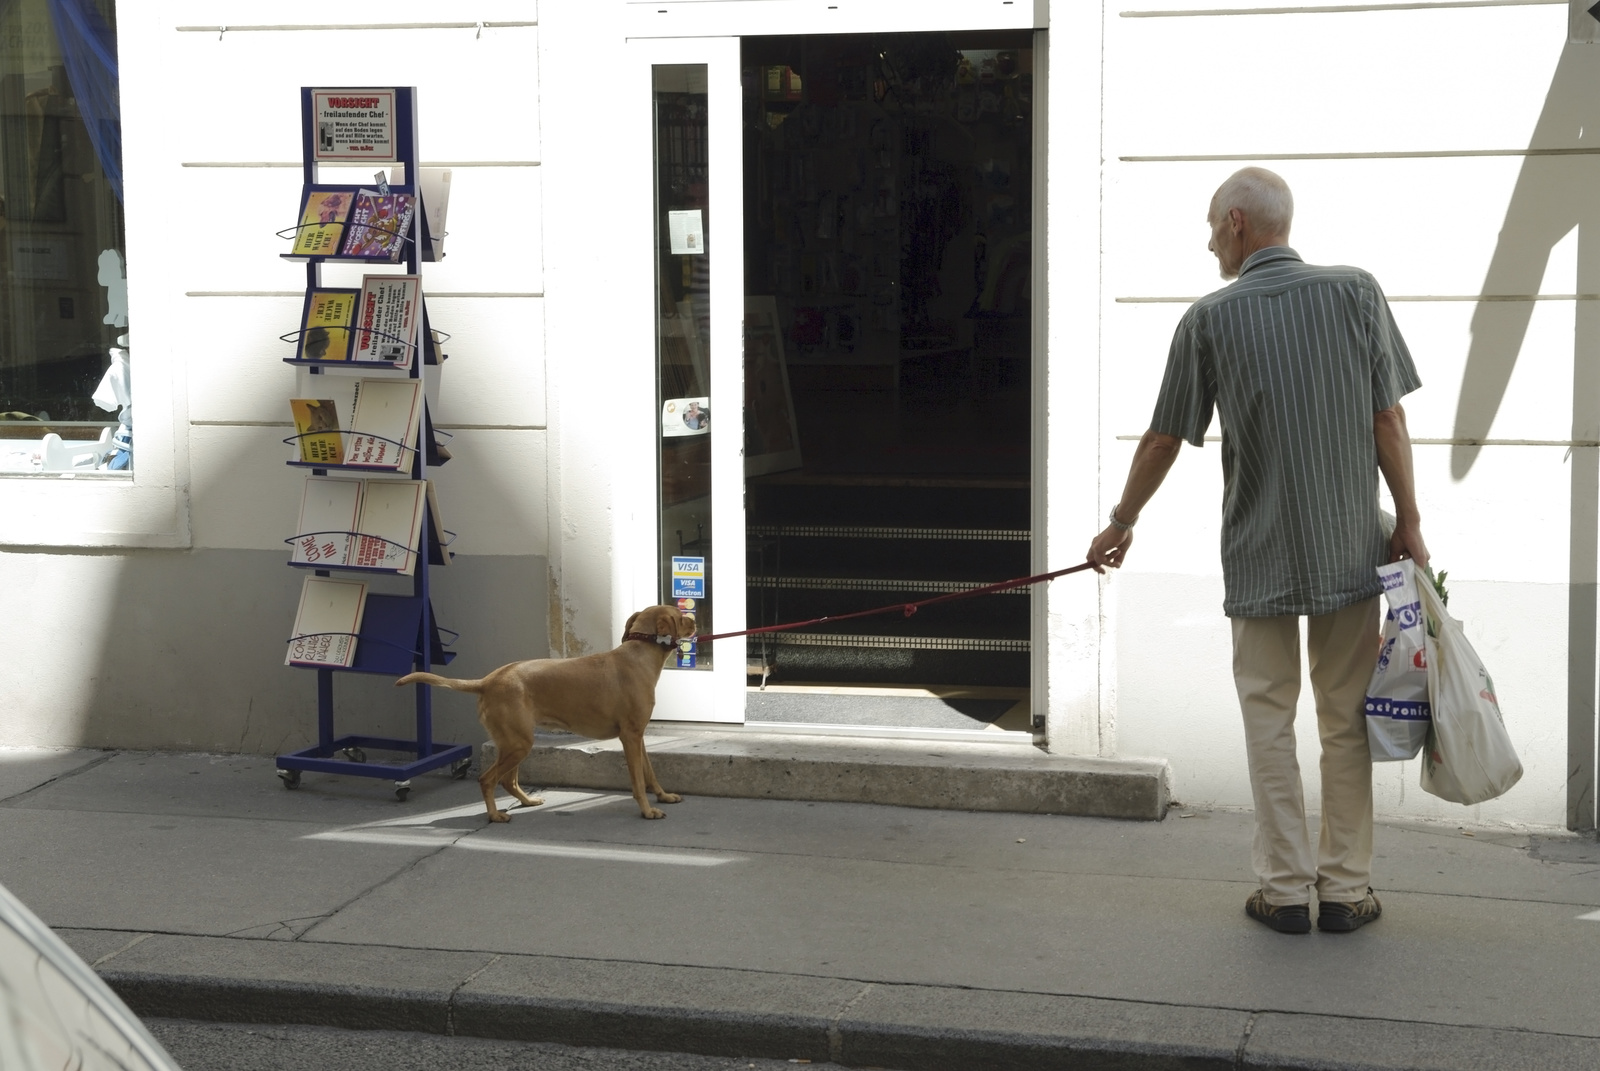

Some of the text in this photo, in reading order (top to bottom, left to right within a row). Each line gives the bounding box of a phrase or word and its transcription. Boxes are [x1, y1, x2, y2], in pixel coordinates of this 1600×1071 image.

[328, 97, 379, 109] VORSICHT
[304, 232, 315, 248] HIER
[312, 231, 325, 251] WACHE
[324, 299, 335, 322] WACHE
[333, 302, 343, 320] HIER
[311, 441, 319, 458] HIER
[319, 439, 328, 461] WACHE
[301, 536, 320, 562] COME
[322, 541, 337, 558] IN!
[678, 563, 699, 571] VISA
